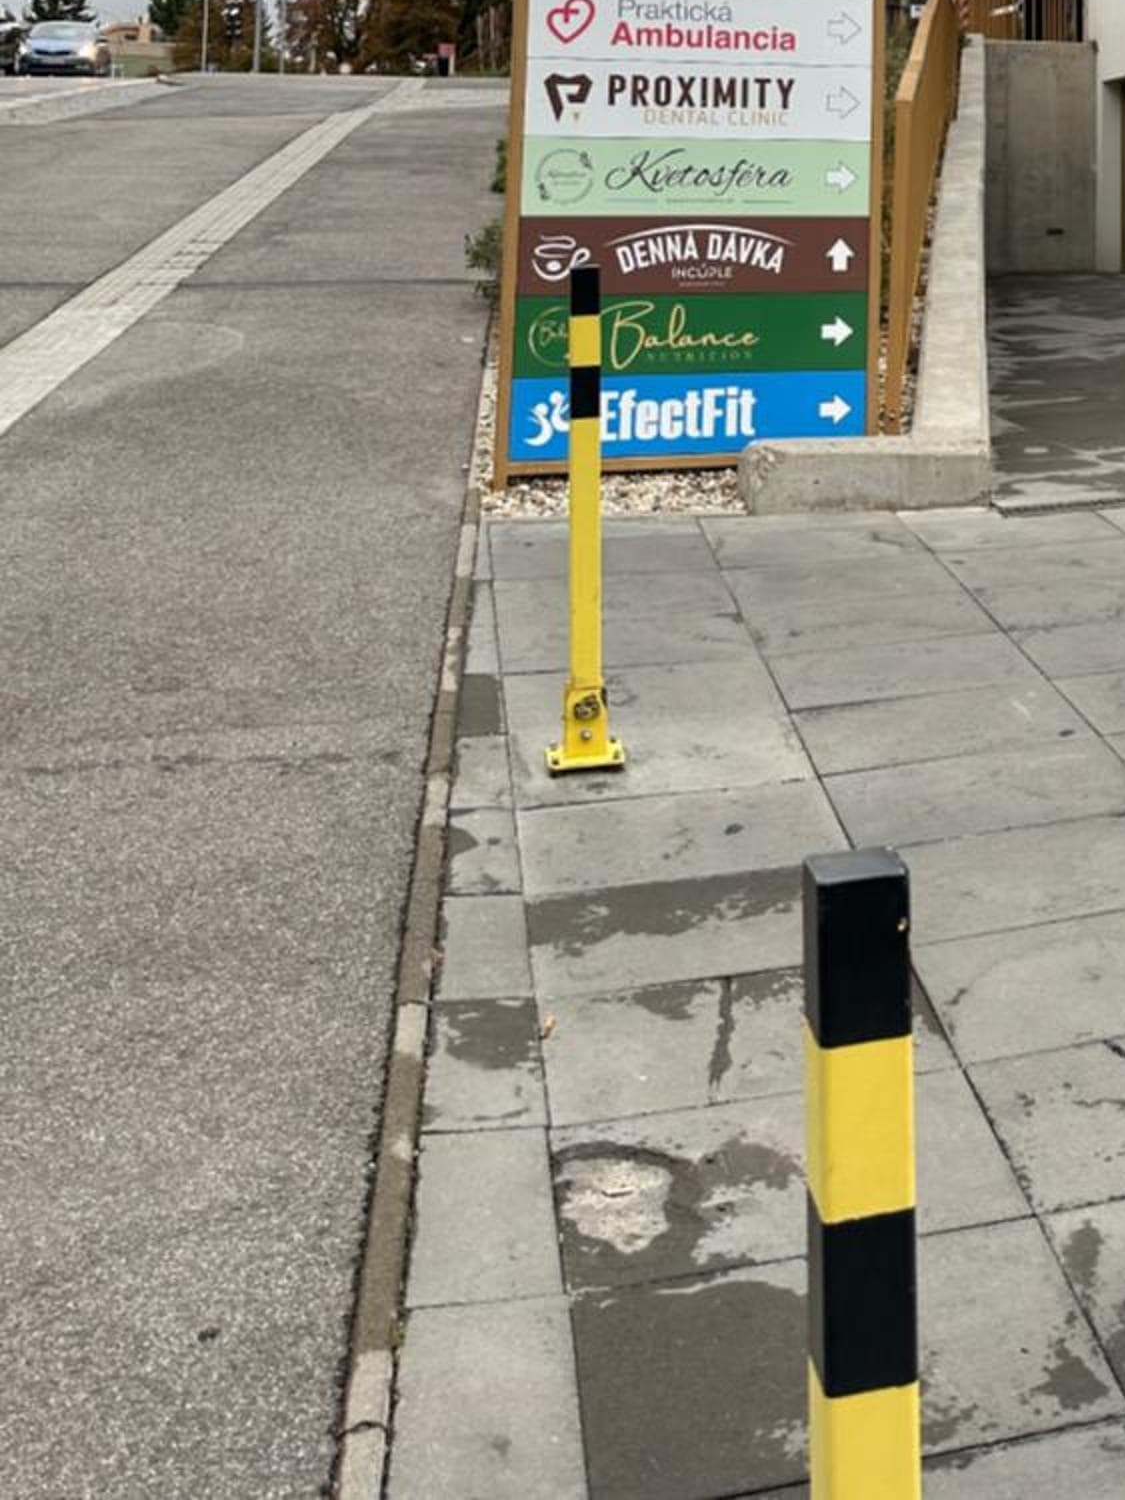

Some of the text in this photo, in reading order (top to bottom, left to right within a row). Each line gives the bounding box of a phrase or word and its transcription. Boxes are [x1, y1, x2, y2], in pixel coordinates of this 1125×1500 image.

[610, 21, 797, 52] Ambulancia
[607, 74, 795, 109] PROXIMITY
[643, 109, 789, 126] DENTAL CLINIC
[604, 148, 793, 196] Kvetosféra
[615, 231, 785, 275] DENNÁ DÁVKA
[600, 300, 760, 370] Balance
[600, 386, 757, 442] EfectFit
